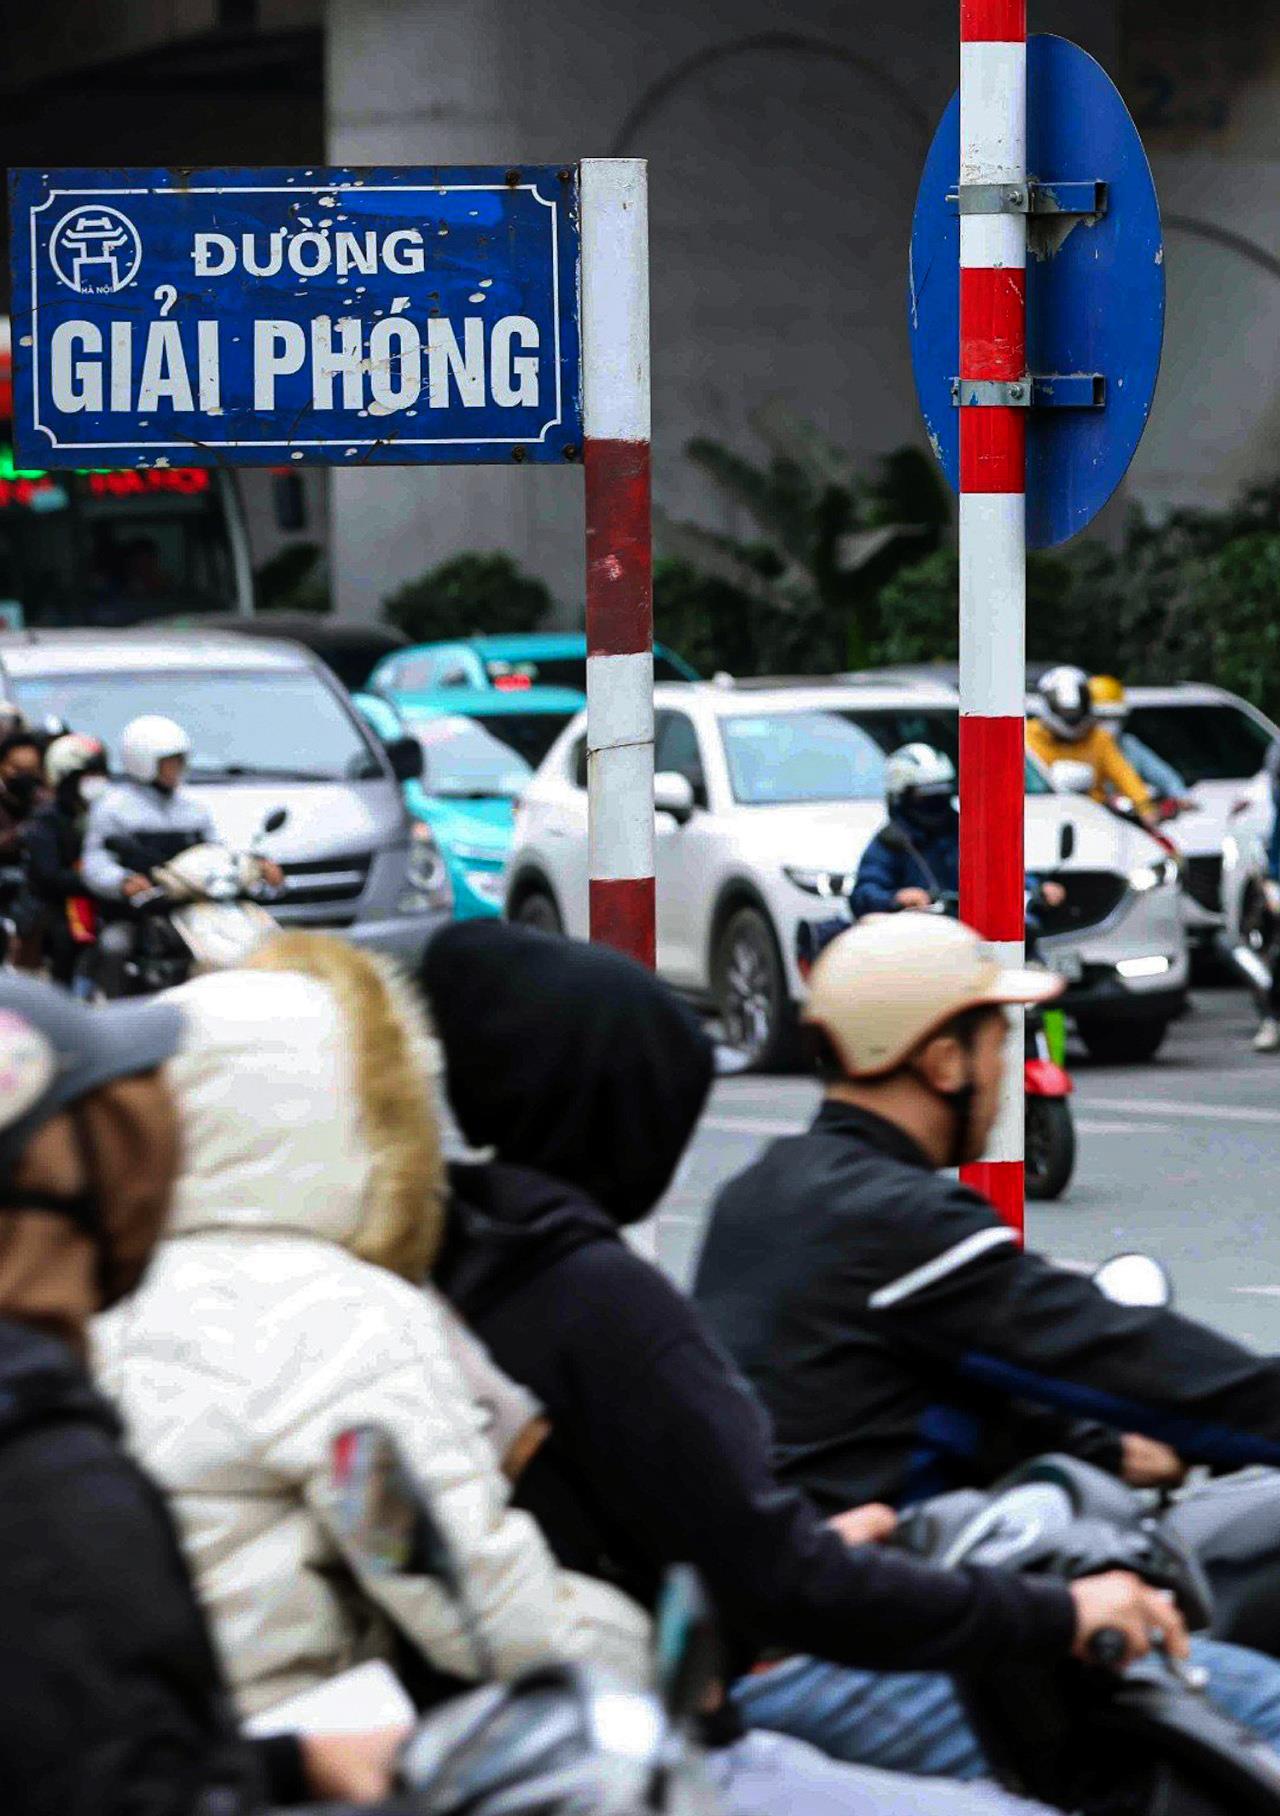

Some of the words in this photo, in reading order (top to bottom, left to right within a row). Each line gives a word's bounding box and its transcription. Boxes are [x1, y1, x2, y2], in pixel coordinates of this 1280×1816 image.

[190, 217, 426, 277] ĐƯỜNG
[51, 286, 220, 413] GIẢI
[253, 297, 540, 413] PHÓNG
